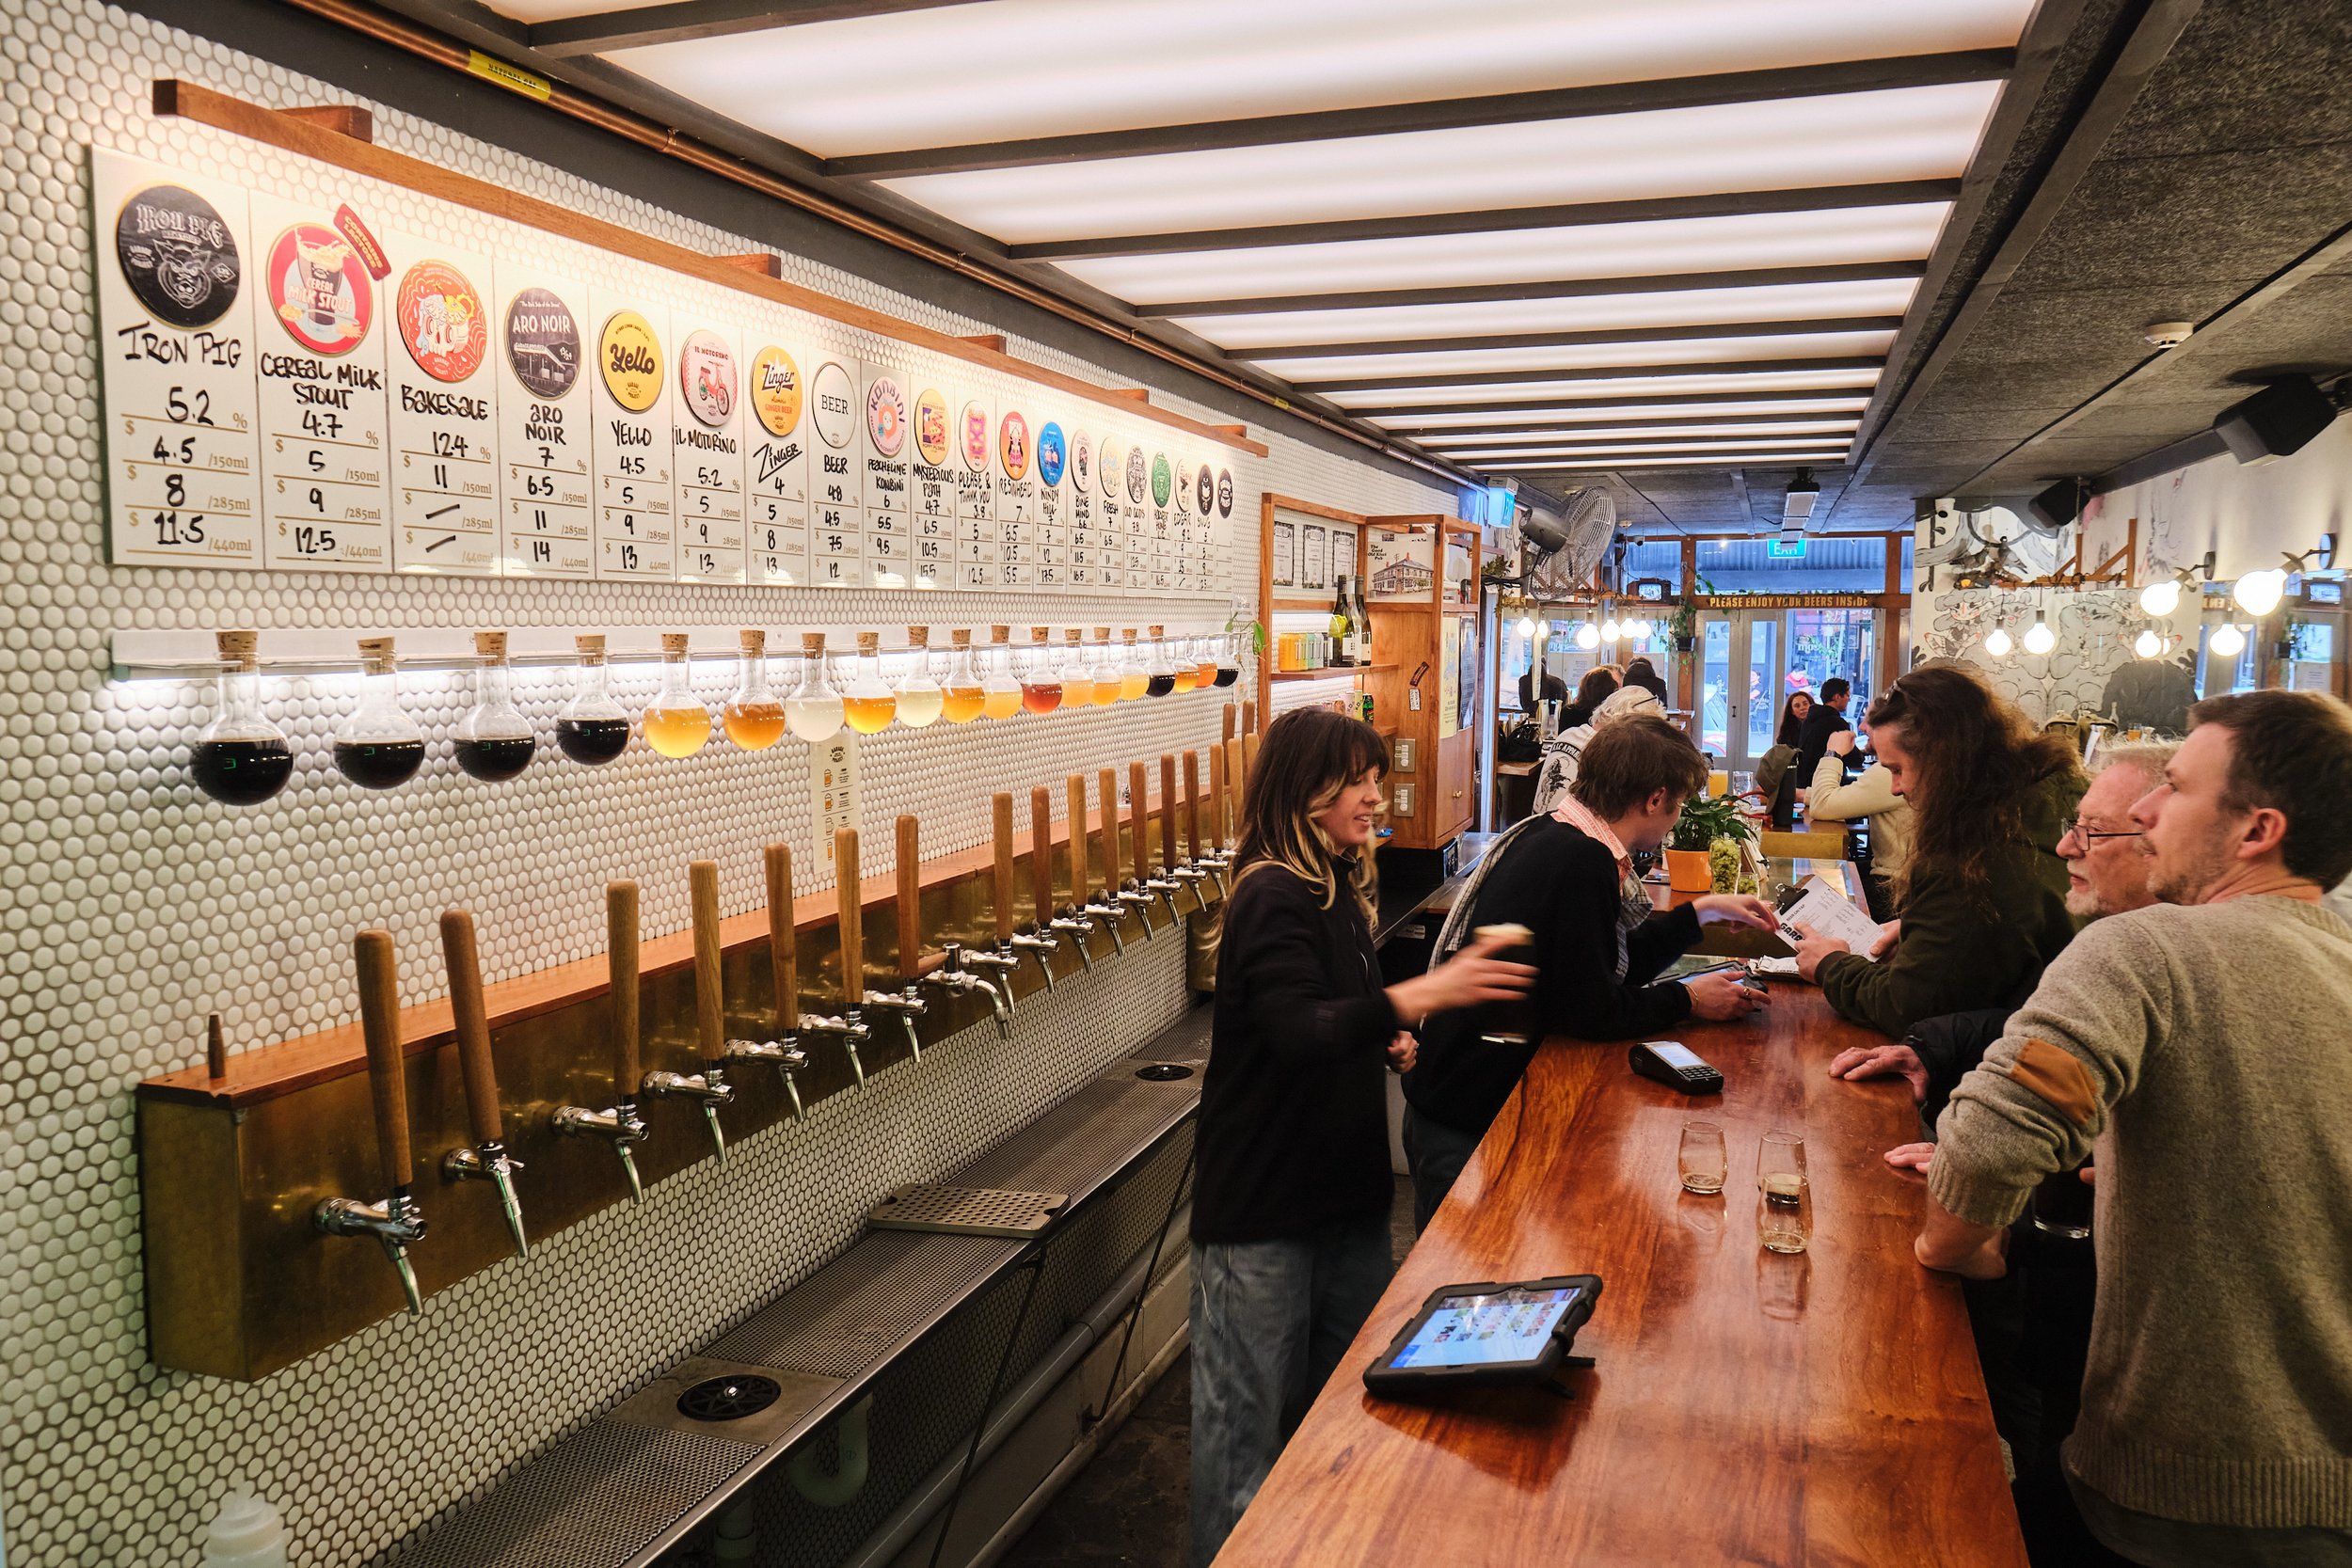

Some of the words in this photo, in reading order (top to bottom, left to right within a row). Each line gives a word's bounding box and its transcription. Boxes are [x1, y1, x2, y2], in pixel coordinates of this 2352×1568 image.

[307, 278, 334, 293] CEREAL
[318, 293, 352, 312] STOUT
[513, 315, 538, 334] ARO
[541, 315, 571, 334] NOIR
[119, 321, 188, 364] IRON
[194, 334, 241, 369] PIG
[610, 343, 655, 374] Yello
[762, 364, 794, 394] Zinger
[166, 387, 215, 426] 5.2
[294, 382, 354, 410] STOUT
[821, 395, 849, 415] BEER
[303, 410, 343, 438] 4.7
[525, 423, 566, 446] NOIR
[152, 437, 196, 465] 4.5
[208, 452, 248, 470] /150ml
[433, 432, 469, 457] 12.4
[308, 451, 326, 471] 5
[345, 468, 380, 483] /150ml
[538, 447, 554, 468] 7
[620, 456, 645, 476] 4.5
[824, 454, 849, 475] BEER
[434, 465, 448, 489] 11
[462, 482, 492, 495] /150ml
[698, 467, 723, 486] 5.2
[775, 477, 785, 495] 4
[166, 474, 185, 506] 8
[208, 495, 250, 512] /285ml
[527, 475, 554, 497] 6.5
[562, 492, 587, 504] /150ml
[623, 487, 634, 504] 5
[310, 487, 324, 513] 9
[345, 506, 381, 521] /285ml
[699, 496, 709, 513] 5
[768, 504, 776, 520] 5
[883, 496, 890, 508] 6
[154, 512, 204, 546] 11.5
[208, 536, 251, 552] /440ml
[462, 516, 493, 530] /285ml
[534, 510, 548, 531] 11
[562, 524, 588, 536] /285ml
[624, 515, 634, 535] 9
[700, 524, 707, 543] 9
[295, 528, 336, 554] 12.5
[344, 545, 382, 559] /440ml
[768, 530, 775, 549] 8
[533, 541, 550, 562] 14
[622, 545, 638, 570] 13
[700, 553, 714, 574] 13
[830, 562, 840, 578] 12
[1709, 596, 1743, 608] PLEASE
[1746, 596, 1773, 608] ENJOY
[1776, 596, 1801, 607] YOUR
[1804, 596, 1833, 607] BEERS
[1836, 595, 1868, 607] INSIDE
[1780, 922, 1805, 942] GARA
